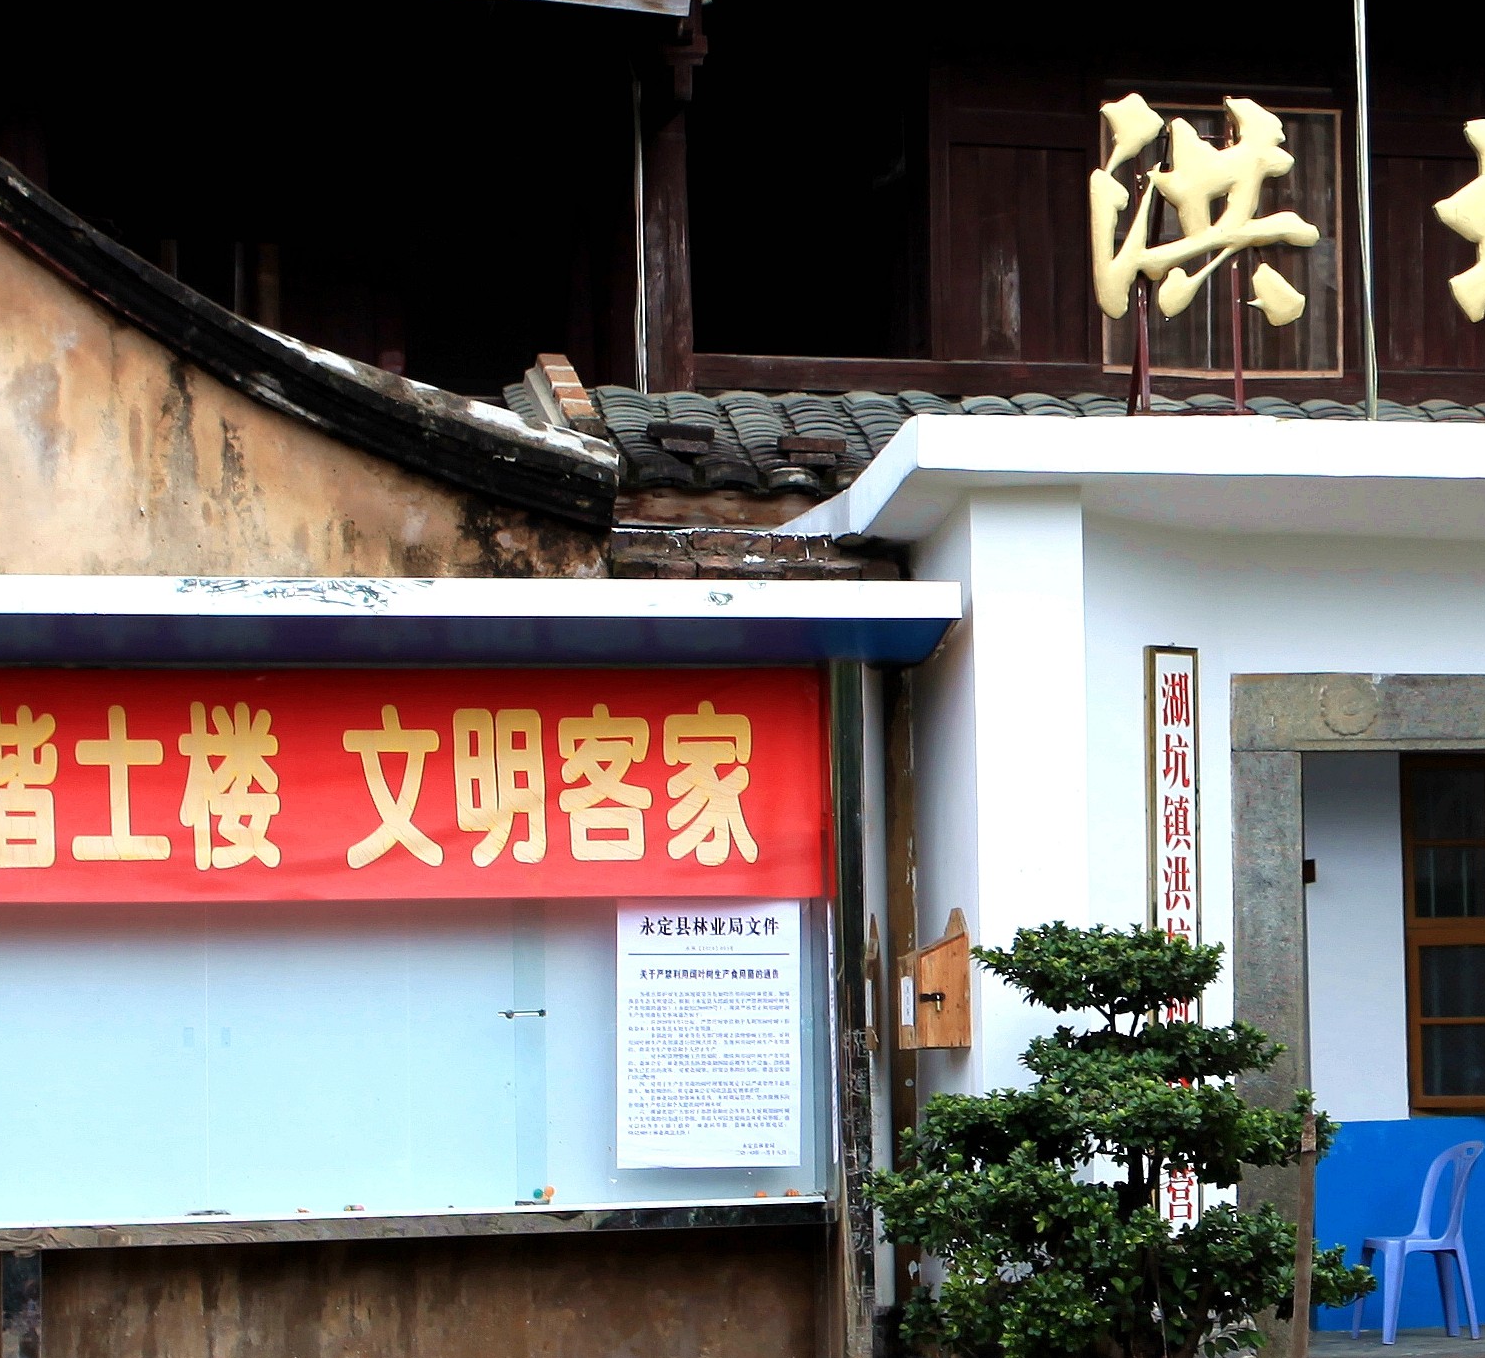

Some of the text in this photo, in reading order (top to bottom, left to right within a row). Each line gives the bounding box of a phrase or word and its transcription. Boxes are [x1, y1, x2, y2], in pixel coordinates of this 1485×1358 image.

[341, 702, 761, 871] 文明客家
[639, 915, 780, 936] 永定县林业局文件
[1162, 672, 1193, 1221] 湖坑镇洪坑营
